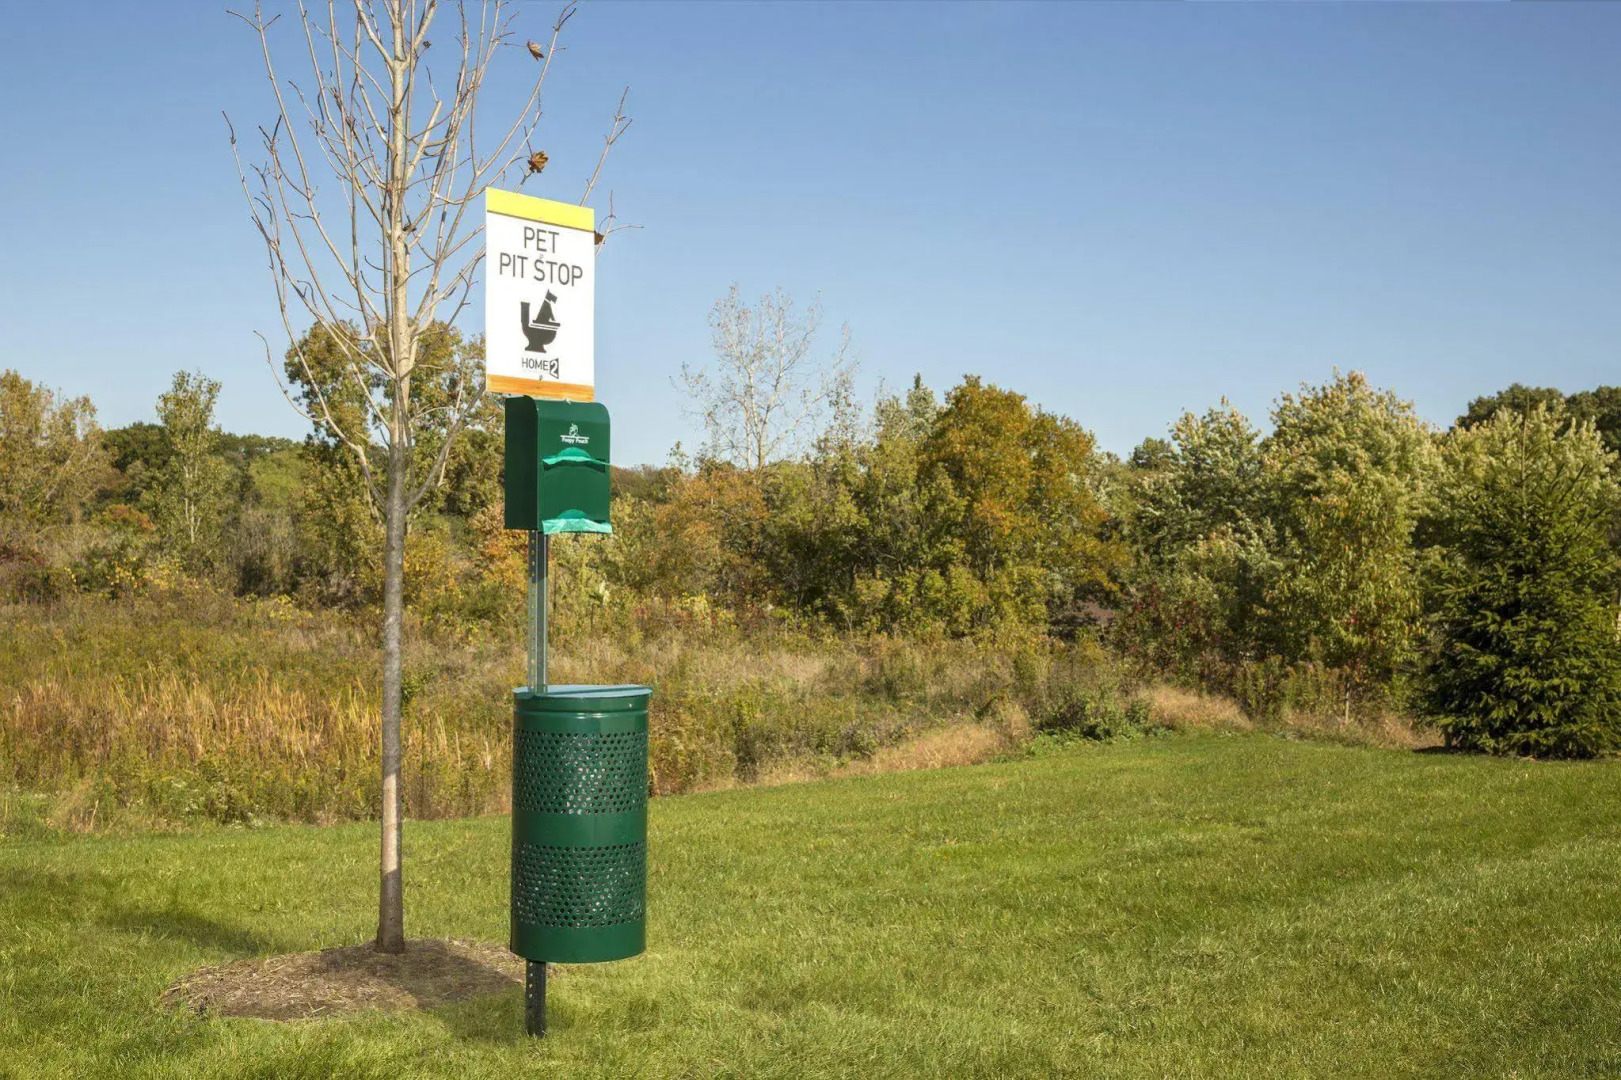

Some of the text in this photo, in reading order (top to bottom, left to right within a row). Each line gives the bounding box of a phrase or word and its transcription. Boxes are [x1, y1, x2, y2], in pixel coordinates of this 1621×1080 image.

[523, 226, 559, 254] PET
[499, 252, 583, 287] PIT STOP
